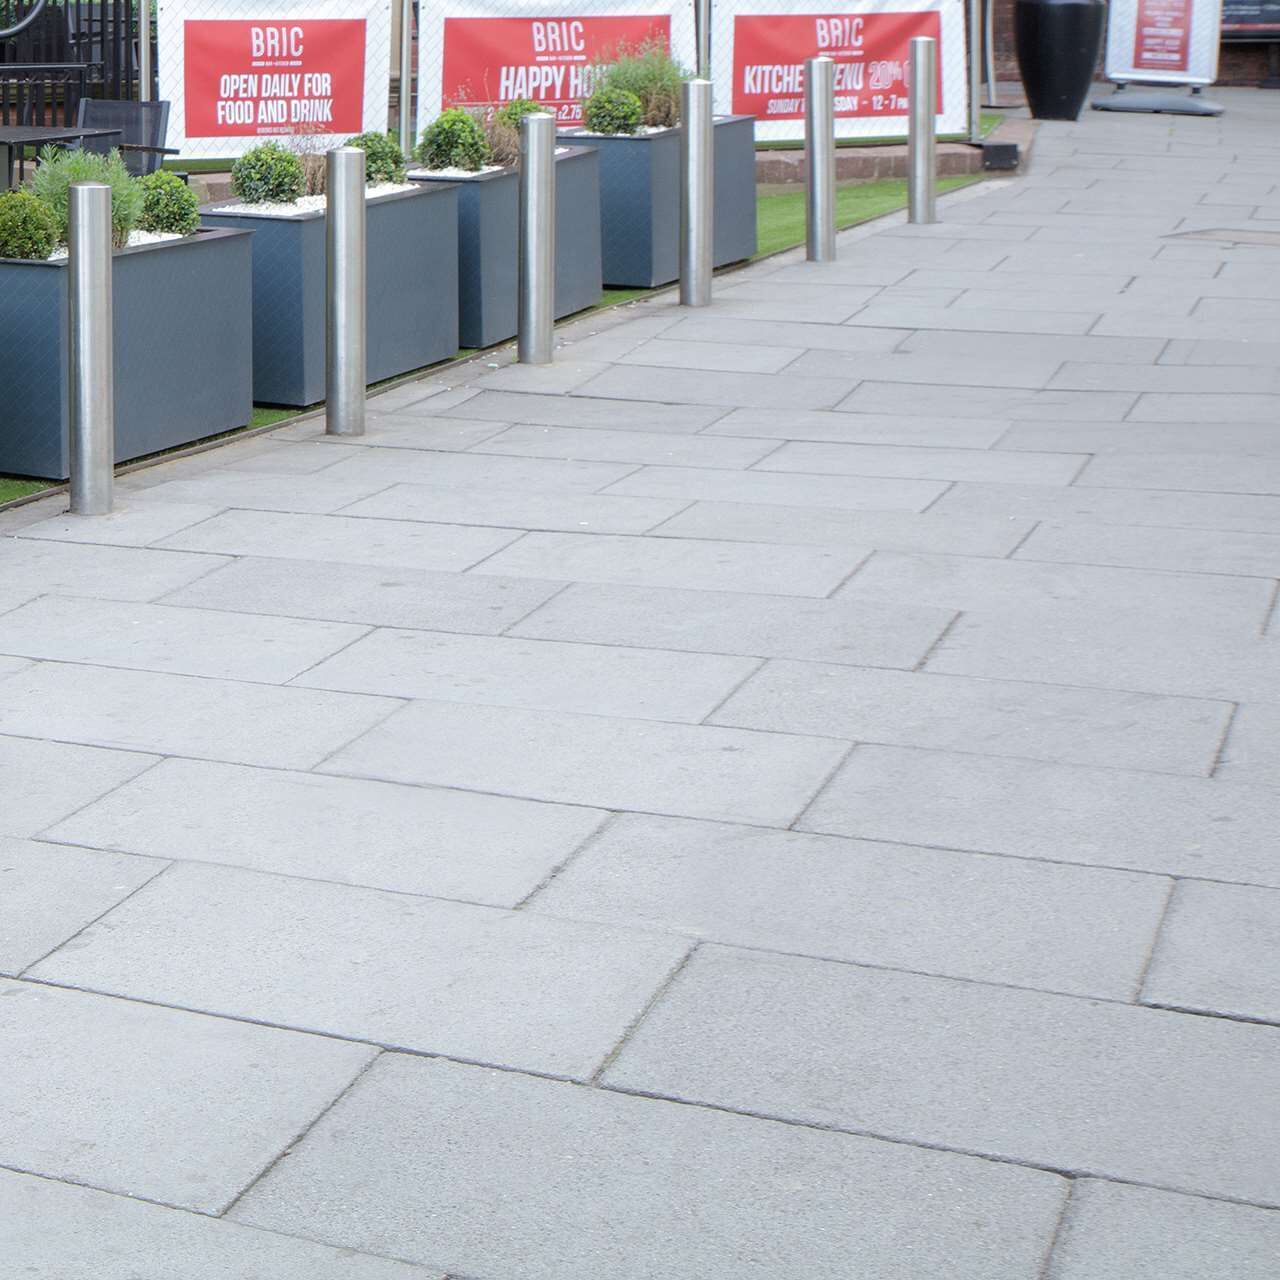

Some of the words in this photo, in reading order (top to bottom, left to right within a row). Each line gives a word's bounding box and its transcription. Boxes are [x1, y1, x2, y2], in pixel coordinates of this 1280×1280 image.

[251, 26, 304, 57] BRIC
[532, 21, 586, 52] BRIC
[816, 18, 865, 49] BRIC
[220, 74, 259, 99] OPEN
[261, 73, 301, 98] DAILY
[303, 73, 332, 97] FOR
[499, 65, 566, 101] HAPPY
[744, 64, 806, 94] KITCHE
[216, 100, 255, 125] FOOD
[257, 100, 288, 124] AND
[290, 98, 334, 123] DRINK
